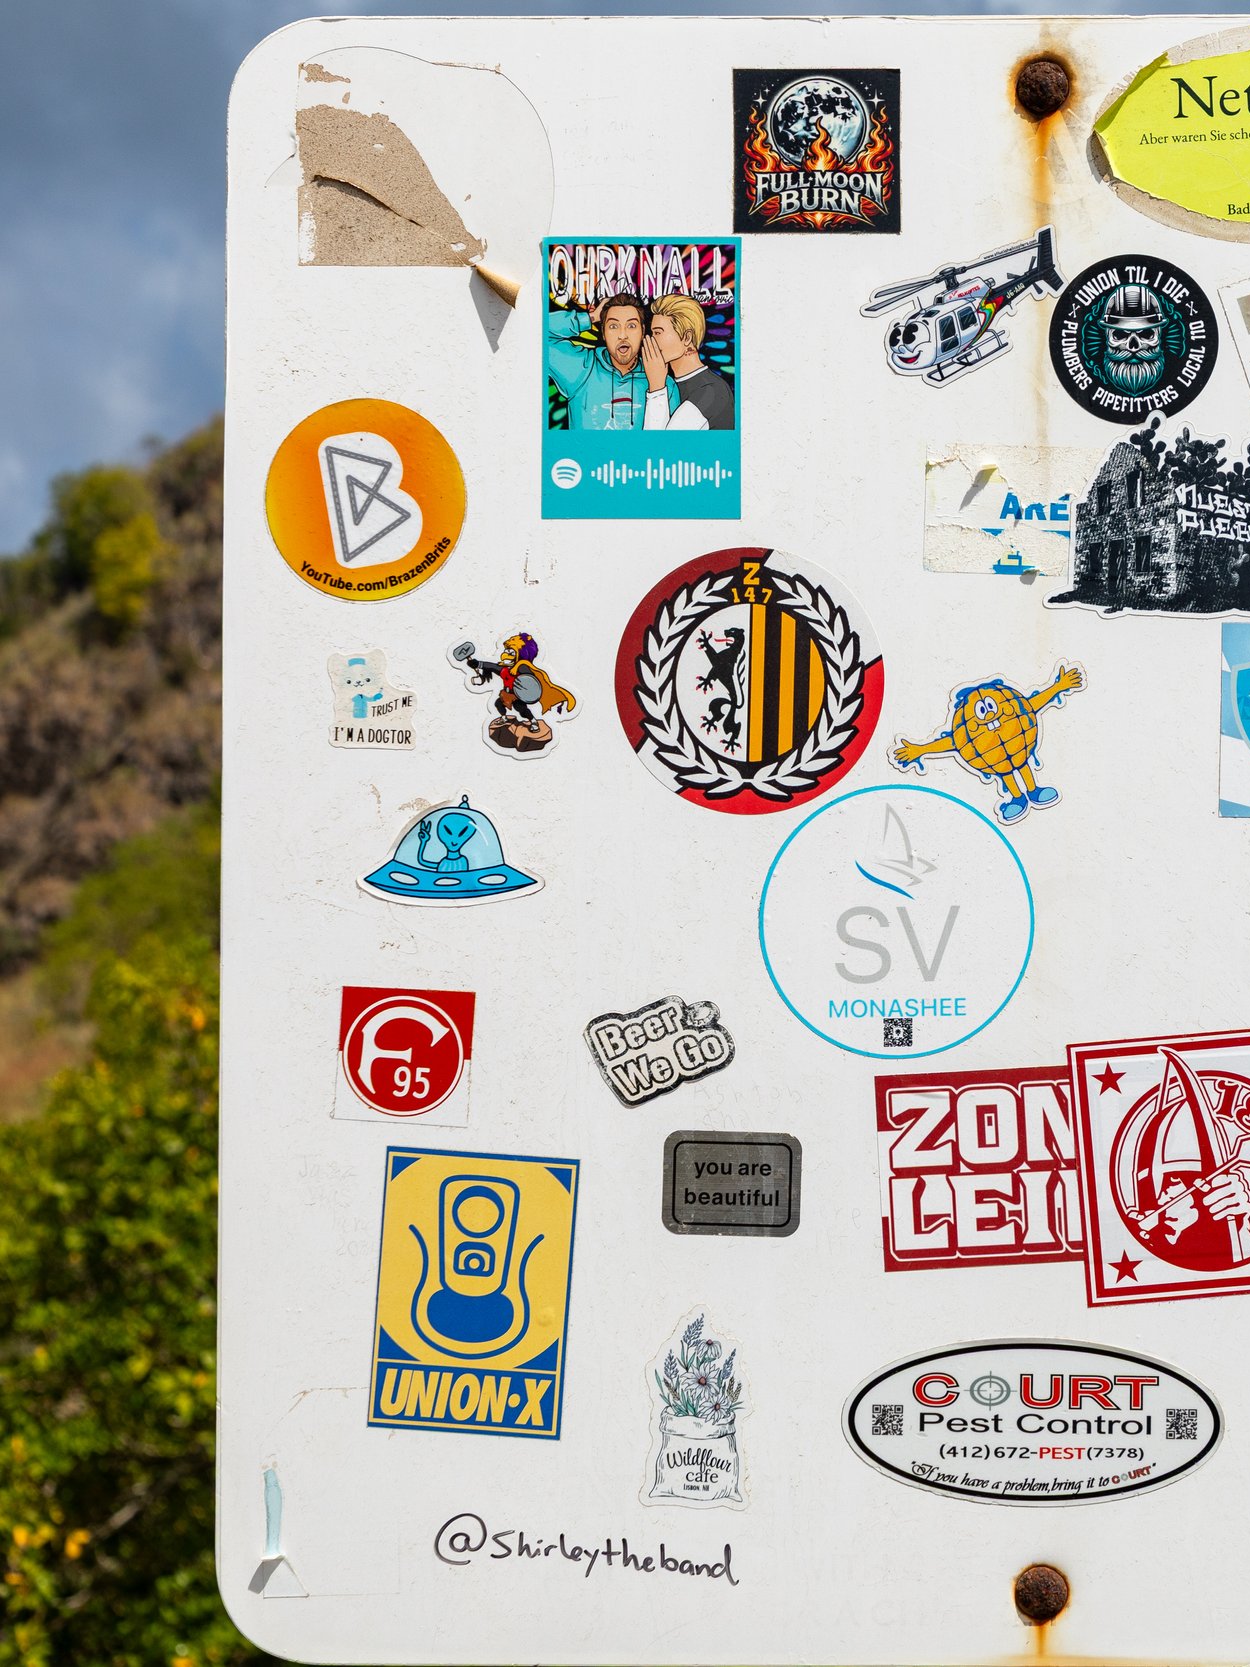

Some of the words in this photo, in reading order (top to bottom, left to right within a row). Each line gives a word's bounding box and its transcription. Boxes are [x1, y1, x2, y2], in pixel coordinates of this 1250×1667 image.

[1139, 132, 1168, 146] Aber
[1171, 131, 1207, 144] waren
[1210, 127, 1227, 141] Sie
[778, 187, 862, 216] BURN
[813, 171, 886, 211] MOON
[550, 245, 734, 305] OHRKNALL
[1074, 268, 1121, 307] UNION
[1125, 266, 1149, 284] TIL
[1153, 271, 1163, 288] I
[1162, 277, 1190, 304] DIE
[1061, 320, 1093, 391] PLUMBERS
[1092, 385, 1179, 413] PIPEFITTERS
[1177, 345, 1206, 387] LOCAL
[300, 536, 451, 591] YouTube.com/BrazenBrits
[731, 588, 773, 603] 147
[371, 700, 399, 718] TRUST
[401, 695, 414, 708] ME
[334, 726, 355, 742] I'M
[357, 728, 365, 743] A
[368, 729, 412, 745] DOGTOR
[834, 905, 960, 985] SV
[828, 998, 967, 1018] MONASHEE
[595, 1006, 679, 1062] Beer
[611, 1053, 674, 1096] We
[673, 1034, 726, 1071] Go
[392, 1066, 431, 1099] 95
[694, 1161, 732, 1179] you
[738, 1163, 772, 1176] are
[684, 1188, 780, 1207] beautiful
[912, 1371, 1160, 1410] COURT
[919, 1412, 1003, 1434] Pest
[1016, 1413, 1152, 1435] Control
[666, 1448, 732, 1473] Wildflour
[685, 1469, 719, 1484] cafe
[936, 1473, 958, 1483] you
[960, 1473, 989, 1489] have
[991, 1481, 1000, 1489] a
[1086, 1477, 1095, 1489] it
[1098, 1476, 1110, 1487] to
